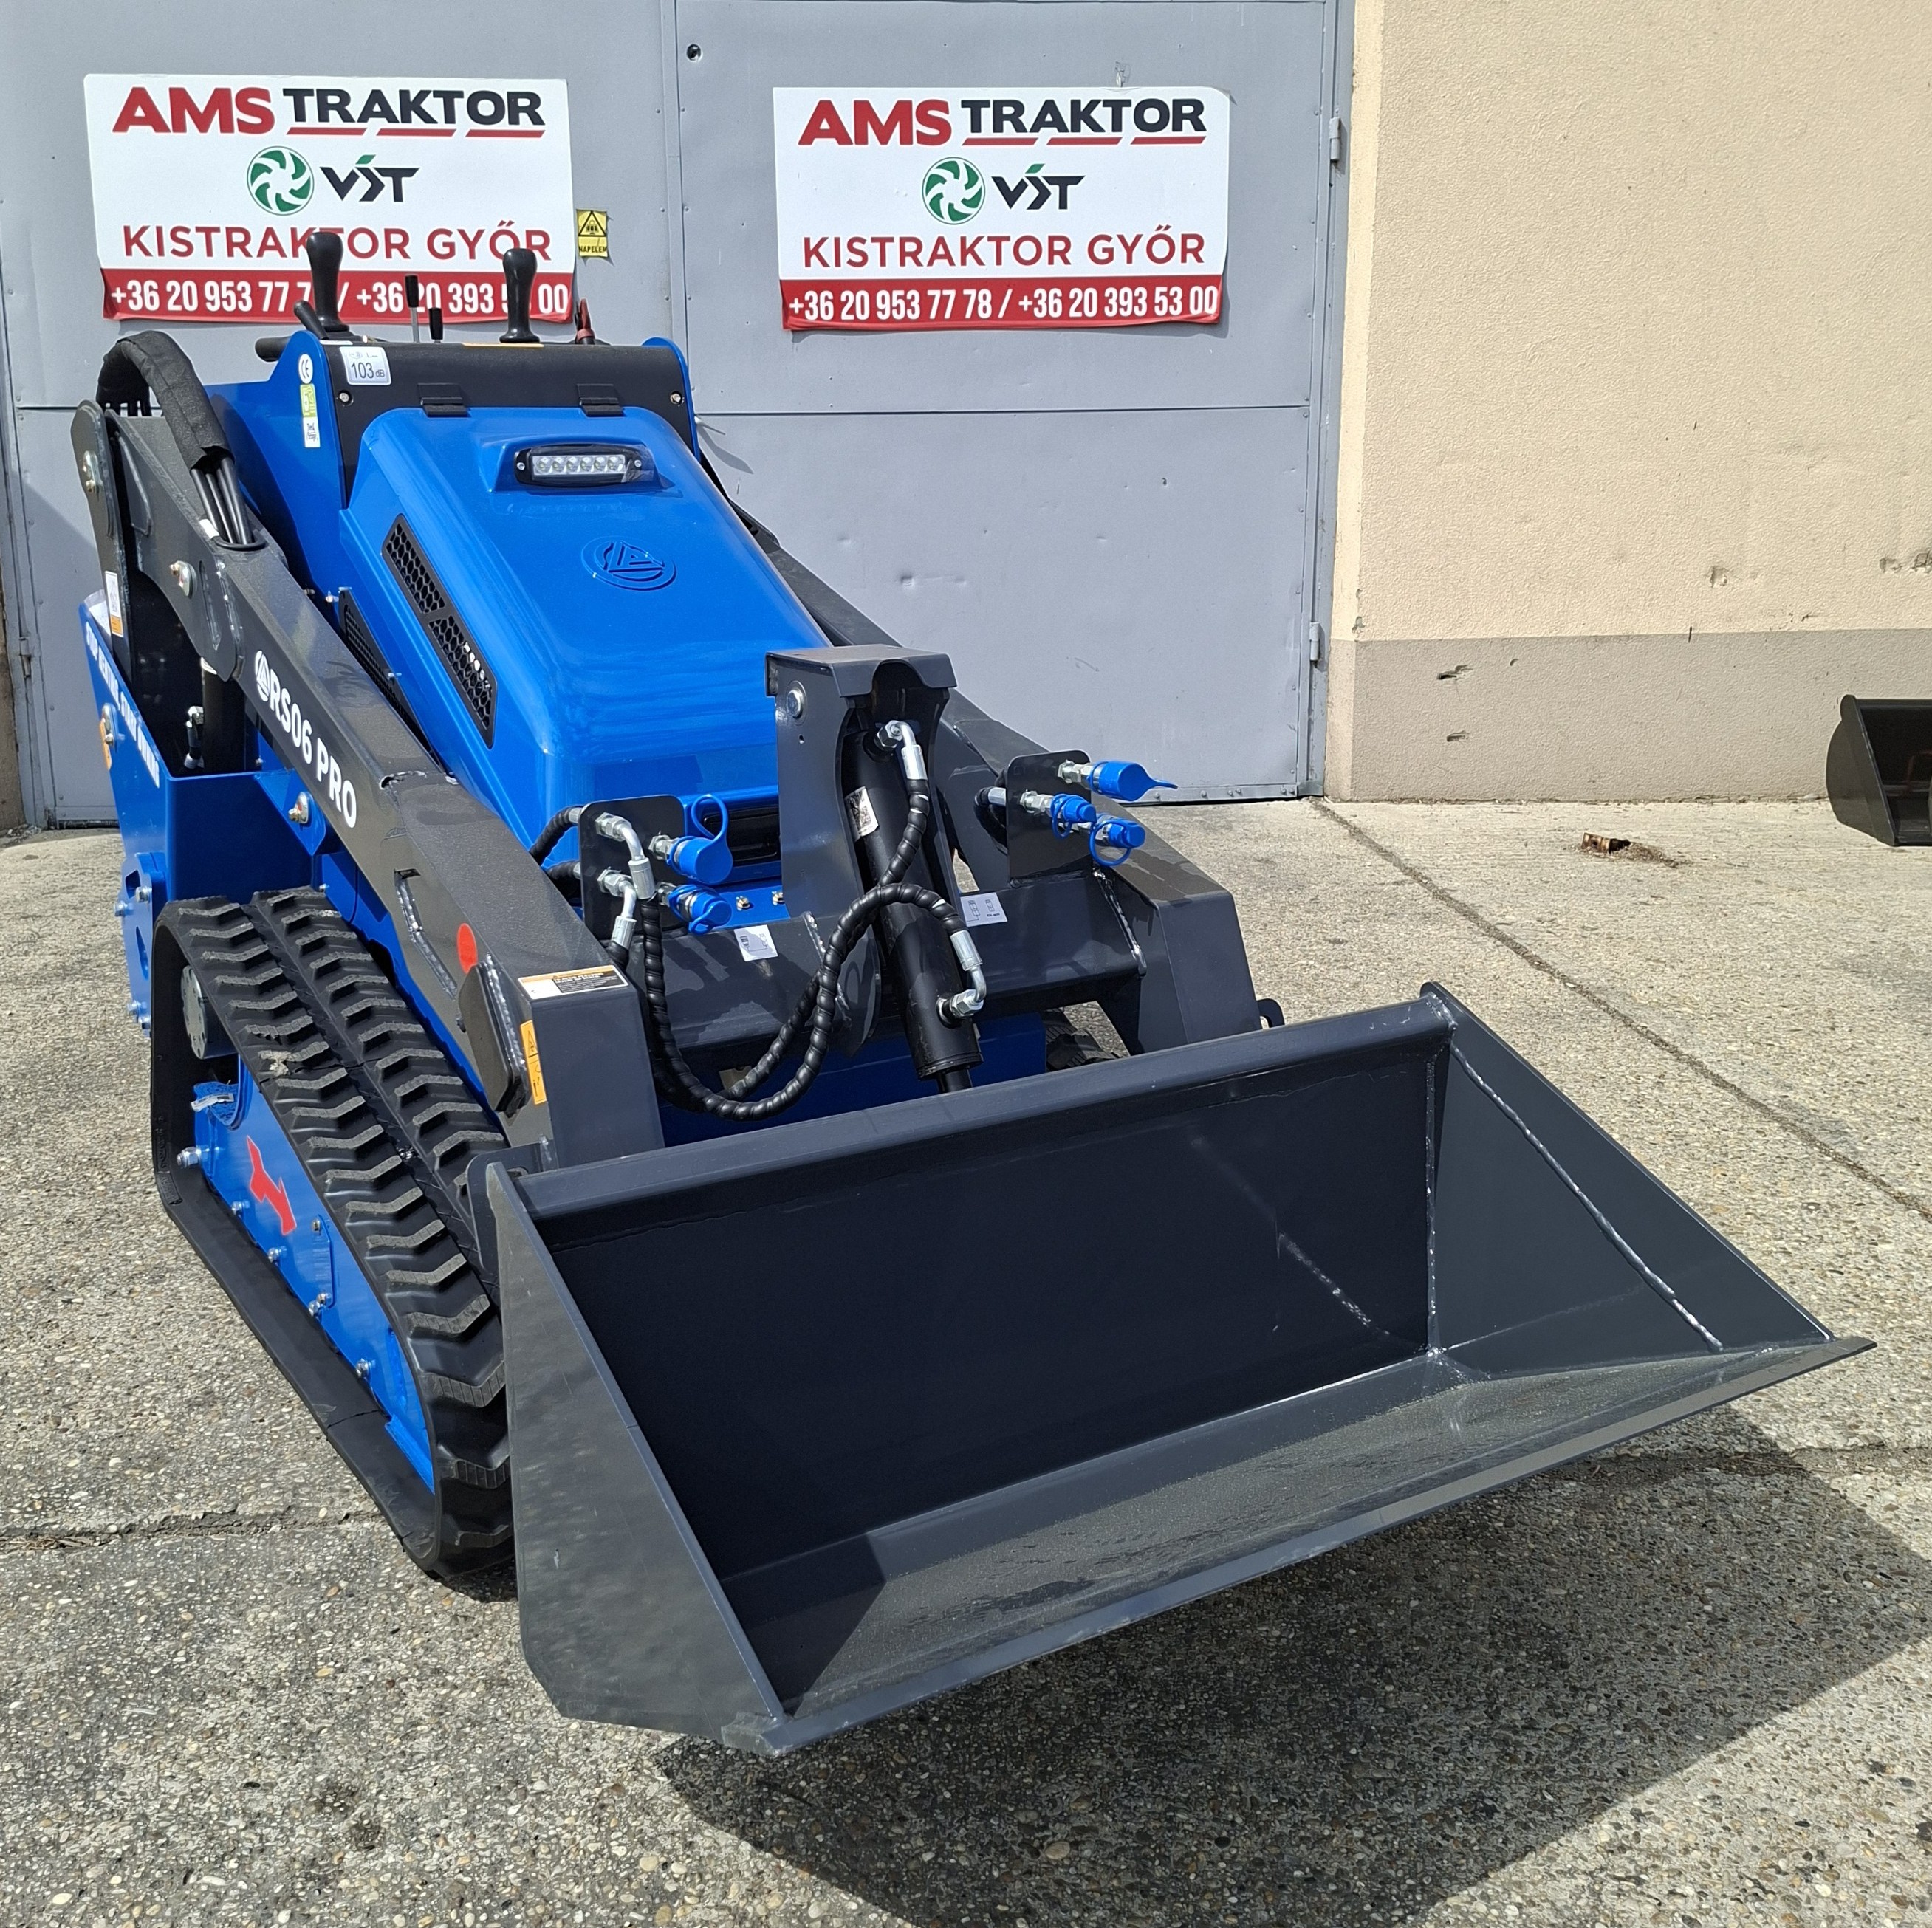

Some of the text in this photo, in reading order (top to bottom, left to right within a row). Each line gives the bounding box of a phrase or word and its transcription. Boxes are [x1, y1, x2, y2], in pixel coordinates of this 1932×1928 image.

[112, 87, 545, 134] AMS TRAKTOR
[798, 98, 1207, 145] AMS TRAKTOR
[426, 219, 552, 261] GYŐR
[804, 224, 1205, 267] KISTRAKTOR GYŐR
[112, 279, 160, 311] +36
[166, 280, 198, 311] 20
[205, 281, 252, 312] 953
[258, 281, 289, 312] 77
[357, 282, 403, 313] +36
[448, 283, 494, 314] 393
[538, 284, 569, 314] 00
[789, 285, 1218, 321] +36 20 953 77 78 / +36 20 393 53 00
[351, 362, 385, 379] 103 dB
[270, 668, 357, 829] RS06 PRO
